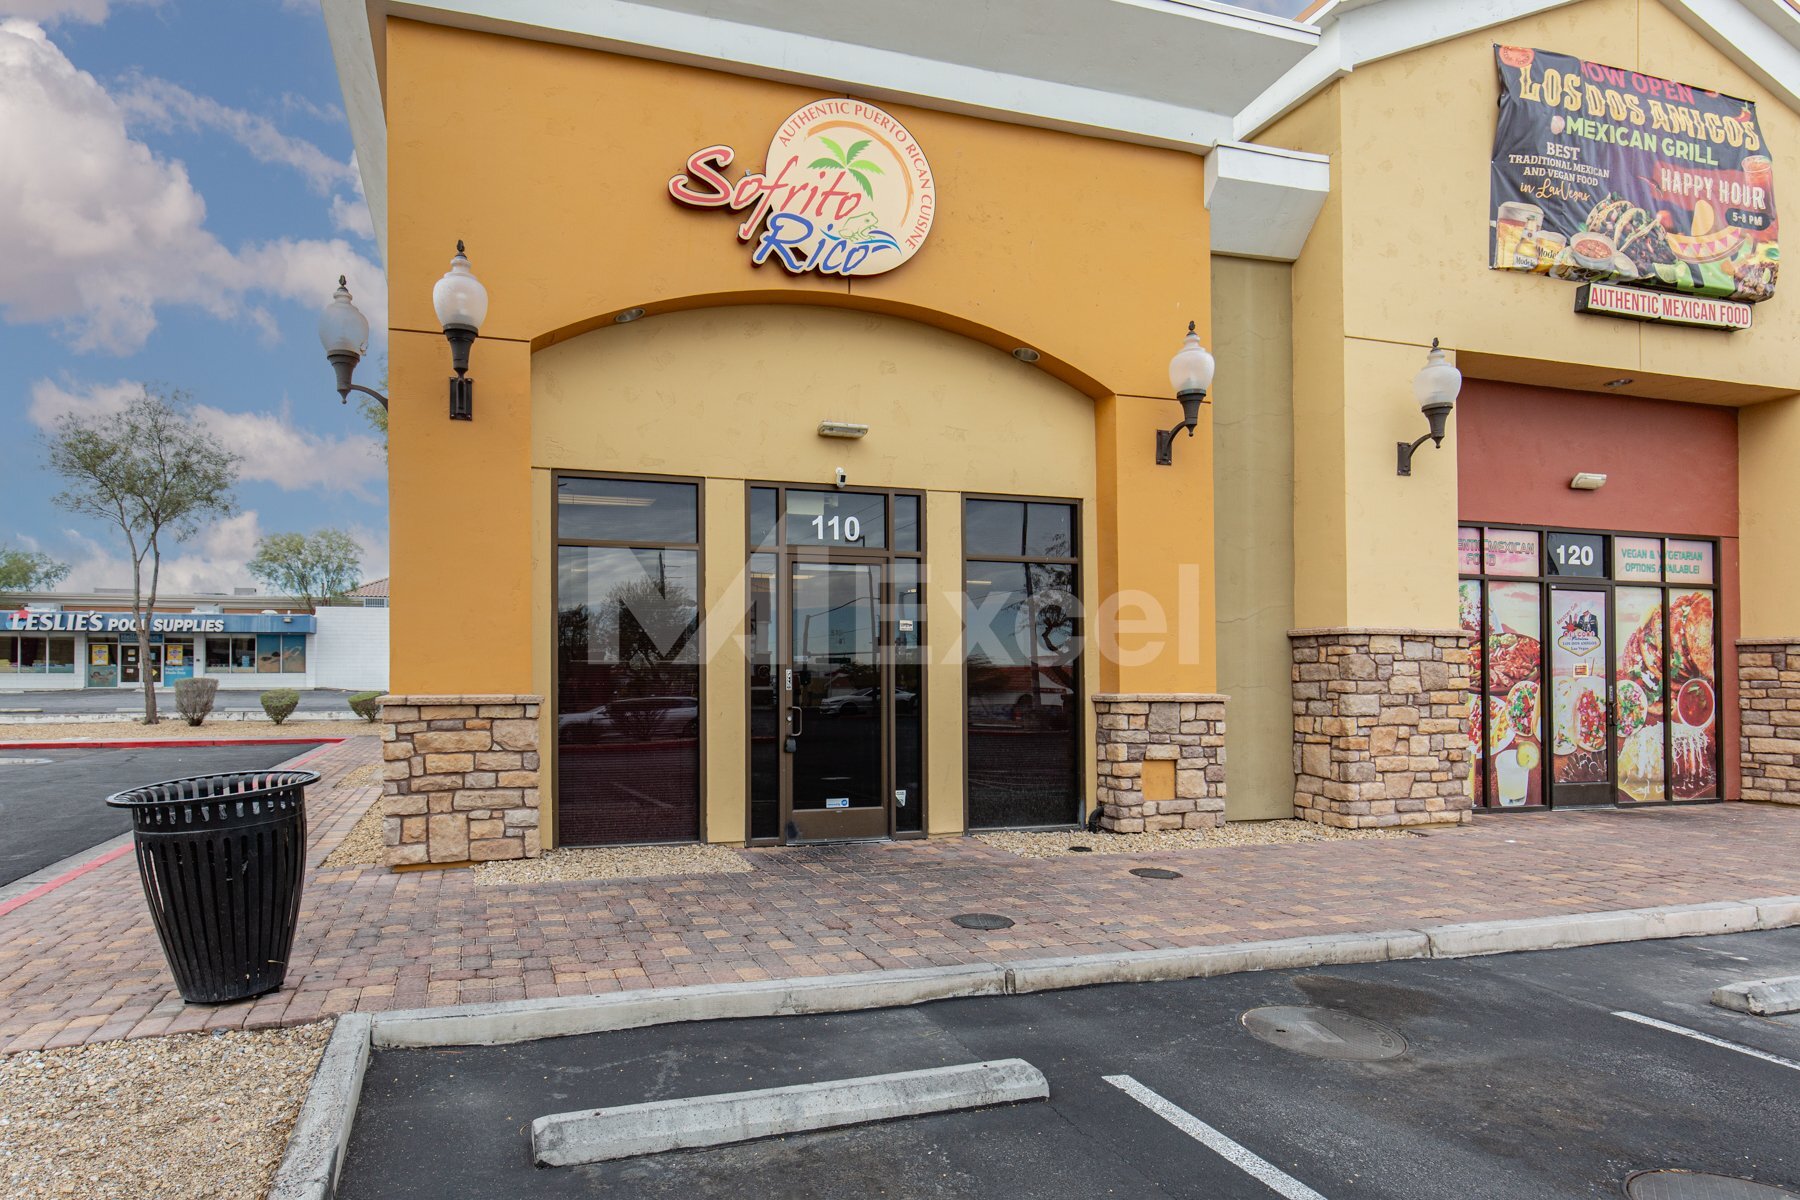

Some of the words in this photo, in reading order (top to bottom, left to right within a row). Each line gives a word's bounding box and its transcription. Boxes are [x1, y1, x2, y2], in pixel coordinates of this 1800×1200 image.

[1632, 72, 1695, 105] OPEN
[855, 104, 907, 143] PUERTO
[1519, 64, 1582, 112] LOS
[1585, 82, 1646, 126] DOS
[1647, 99, 1760, 151] AMIGOS
[778, 102, 850, 147] AUTHENTIC
[1566, 115, 1657, 152] MEXICAN
[1662, 140, 1719, 167] GRILL
[905, 143, 932, 189] RICAN
[1508, 154, 1572, 170] TRADITIONAL
[1573, 163, 1610, 179] MEXICAN
[1546, 142, 1580, 160] BEST
[671, 148, 862, 237] Sofrito
[1520, 182, 1535, 194] in
[1523, 166, 1546, 177] AND
[1547, 169, 1575, 182] VEGAN
[1576, 175, 1599, 186] FOOD
[1661, 167, 1713, 201] HAPPY
[1719, 179, 1766, 210] HOUR
[905, 194, 933, 250] CUISINE
[756, 212, 869, 272] Rico
[1590, 287, 1659, 315] AUTHENTIC
[1662, 295, 1717, 322] MEXICAN
[1719, 302, 1750, 326] FOOD
[812, 515, 861, 541] 110
[1488, 540, 1535, 555] MEXICAN
[1556, 545, 1594, 566] 120
[1621, 548, 1647, 559] VEGAN
[1657, 550, 1703, 561] VGETARIAN
[1625, 562, 1656, 573] OPTIONS
[153, 619, 224, 632] SUPPLIES
